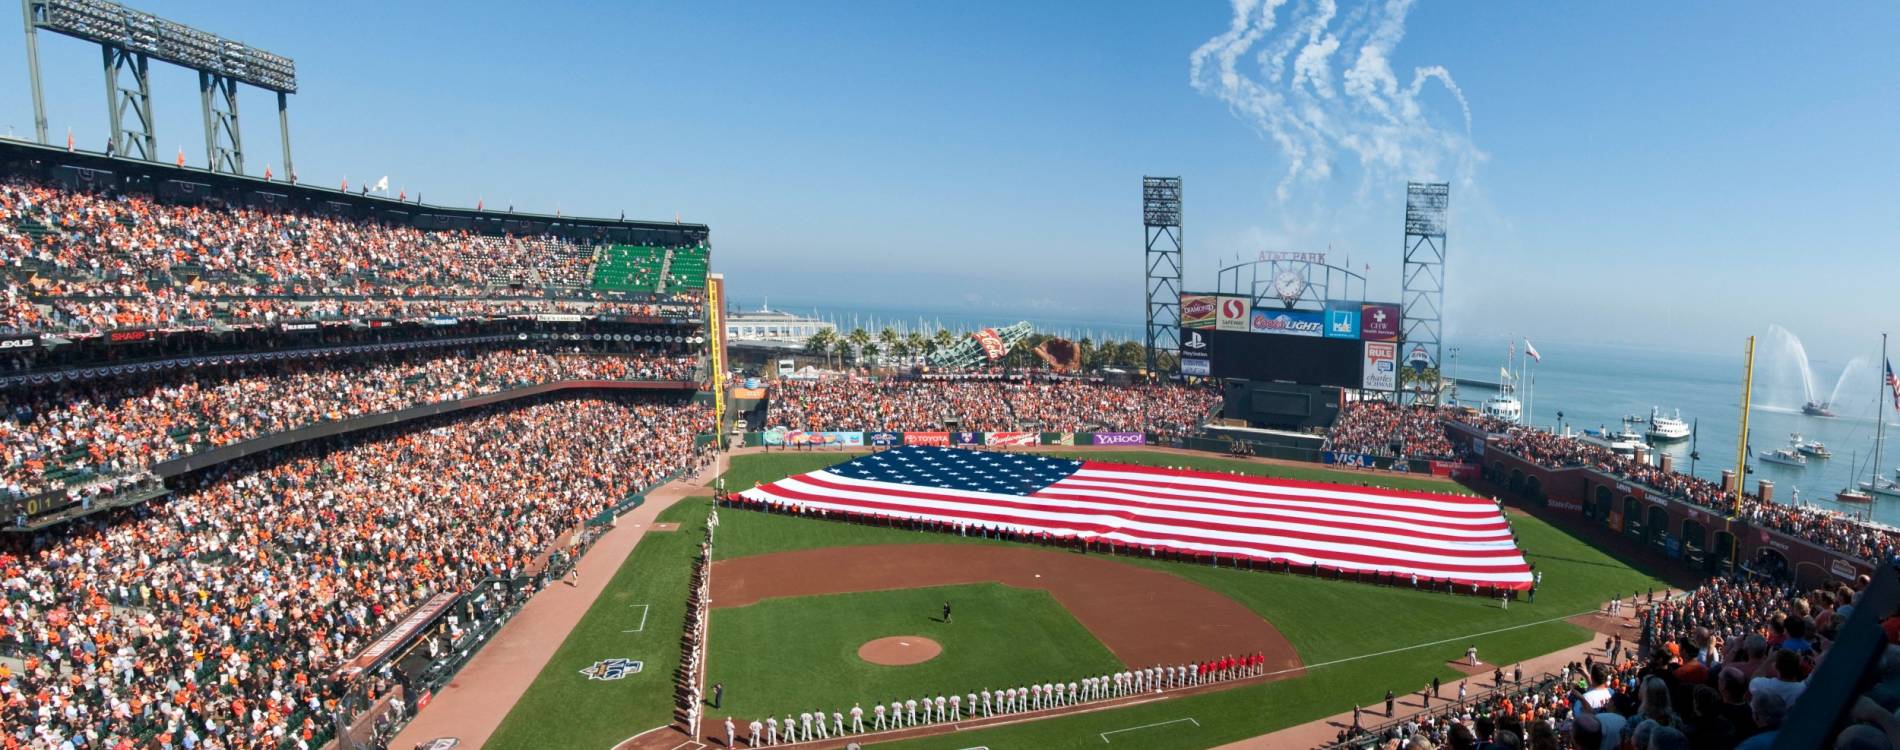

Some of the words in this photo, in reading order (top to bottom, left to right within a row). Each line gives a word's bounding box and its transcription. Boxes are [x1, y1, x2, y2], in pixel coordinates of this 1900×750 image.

[1293, 252, 1326, 264] PARK
[1285, 320, 1320, 332] LIGHT
[112, 332, 145, 341] SHARP
[1369, 349, 1393, 358] RULE
[1096, 434, 1142, 444] YAHOO!
[1334, 453, 1364, 466] VISA
